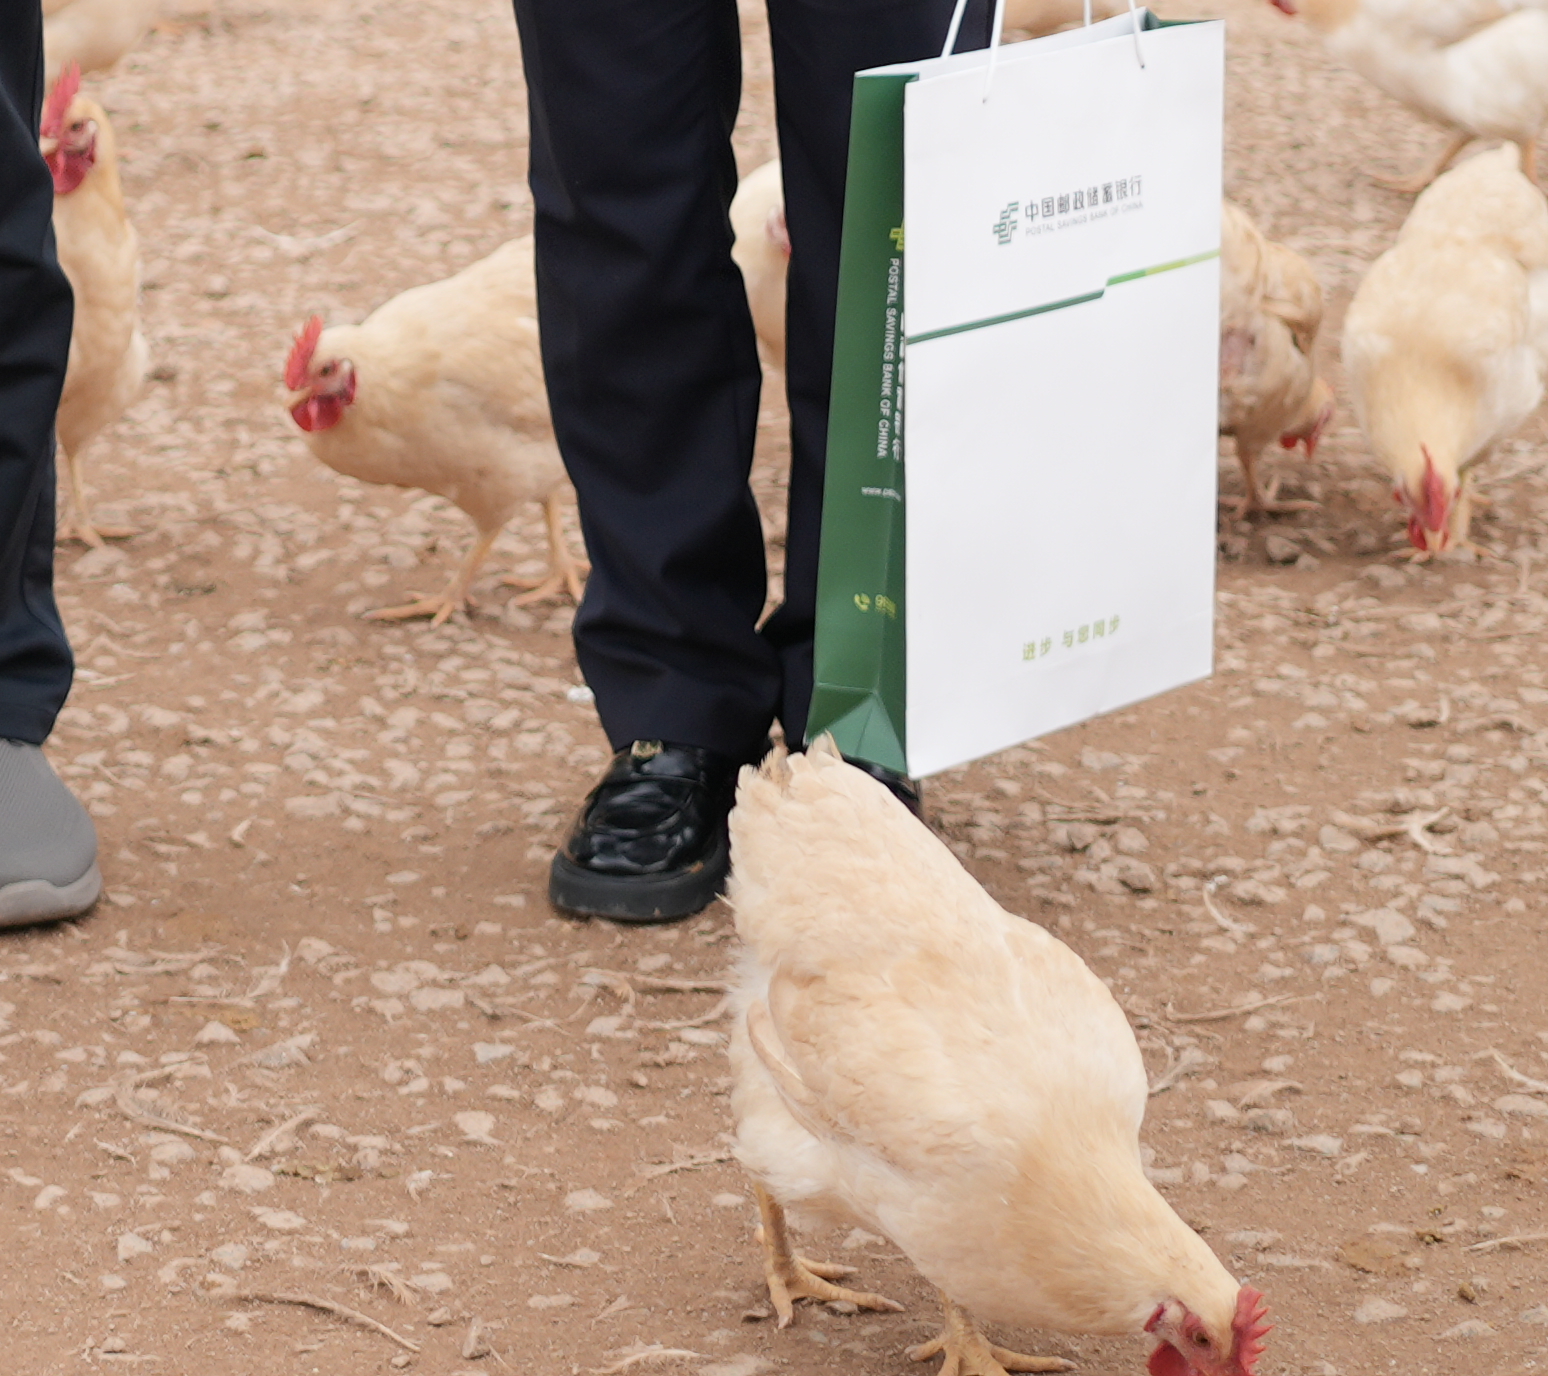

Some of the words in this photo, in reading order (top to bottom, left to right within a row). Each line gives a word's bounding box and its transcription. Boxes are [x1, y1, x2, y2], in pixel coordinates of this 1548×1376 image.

[1025, 175, 1142, 222] 中国邮政储蓄银行
[886, 258, 900, 305] POSTAL
[883, 307, 897, 360] SAVINGS
[880, 363, 894, 396] BANK
[879, 399, 891, 416] OF
[876, 419, 892, 459] CHINA
